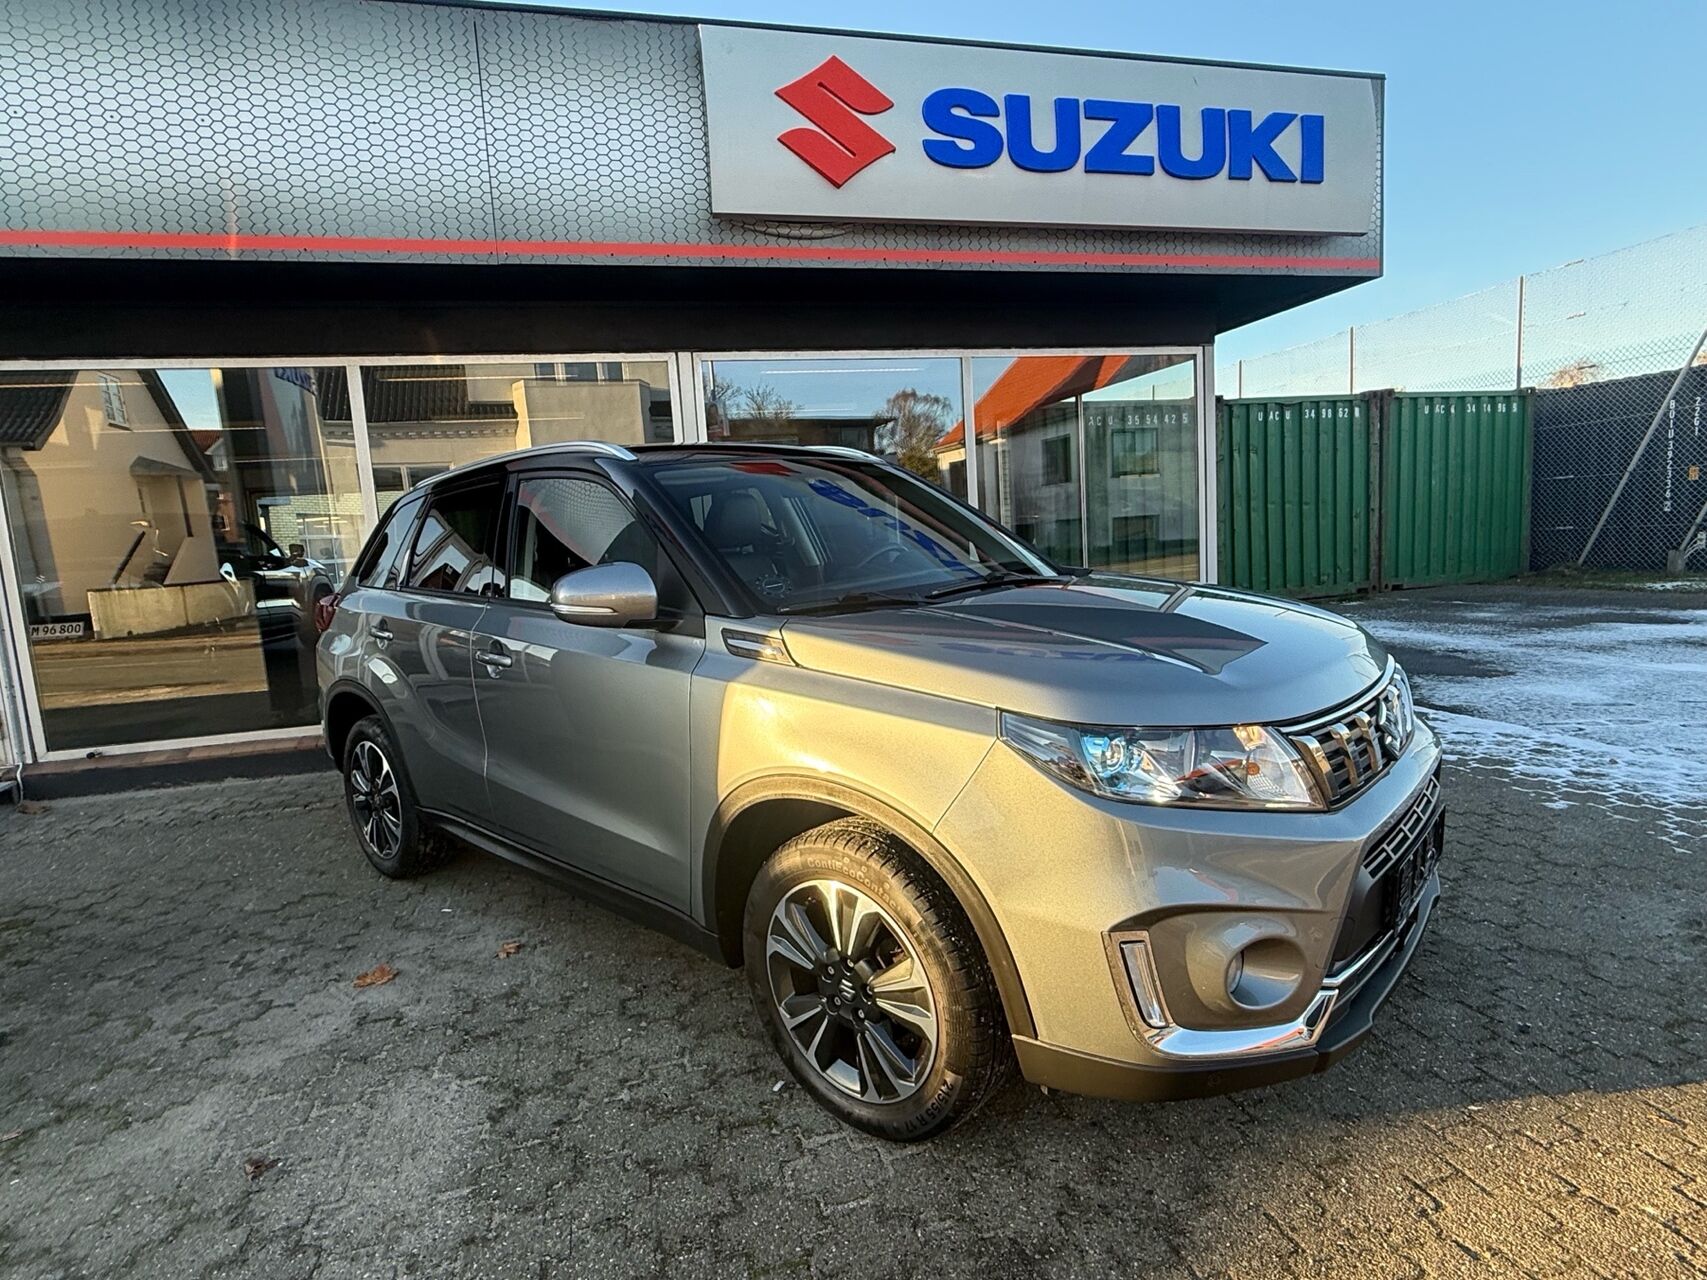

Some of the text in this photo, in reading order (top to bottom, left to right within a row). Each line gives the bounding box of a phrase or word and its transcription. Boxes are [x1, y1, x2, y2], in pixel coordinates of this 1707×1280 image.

[922, 87, 1324, 184] SUZUKI
[42, 625, 57, 635] 96
[59, 623, 81, 635] 800
